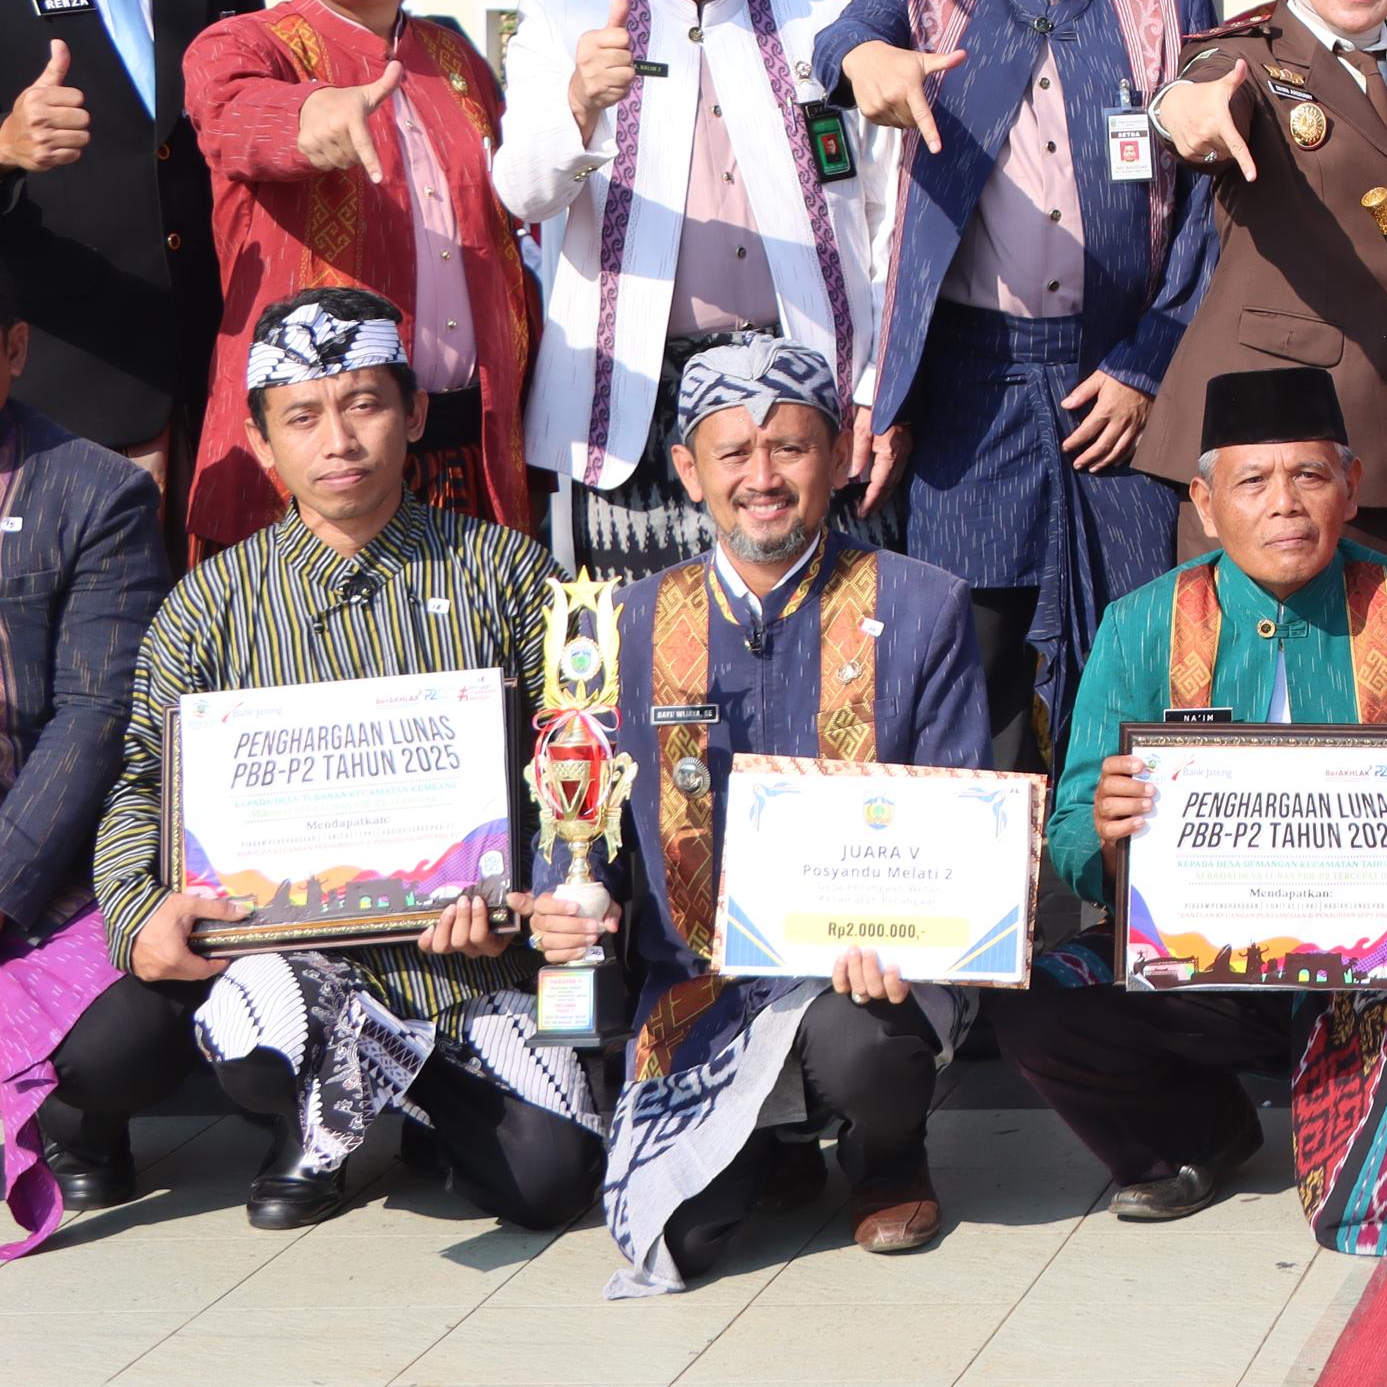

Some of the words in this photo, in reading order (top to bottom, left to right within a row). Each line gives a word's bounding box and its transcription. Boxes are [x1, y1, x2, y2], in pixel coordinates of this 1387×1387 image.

[1183, 714, 1214, 722] NA'IM
[233, 720, 384, 760] PENGHARGAAN
[391, 714, 457, 745] LUNAS
[230, 756, 316, 790] PBB-P2
[323, 748, 397, 781] TAHUN
[402, 744, 462, 775] 2025
[1181, 791, 1331, 820] PENGHARGAAN
[1177, 821, 1263, 849] PBB-P2
[1269, 821, 1343, 849] TAHUN
[840, 844, 901, 862] JUARA
[908, 846, 921, 861] V
[803, 864, 881, 881] Posyandu
[888, 866, 939, 880] Melati
[943, 868, 953, 880] 2
[828, 921, 927, 941] Rp2.000.000,-
